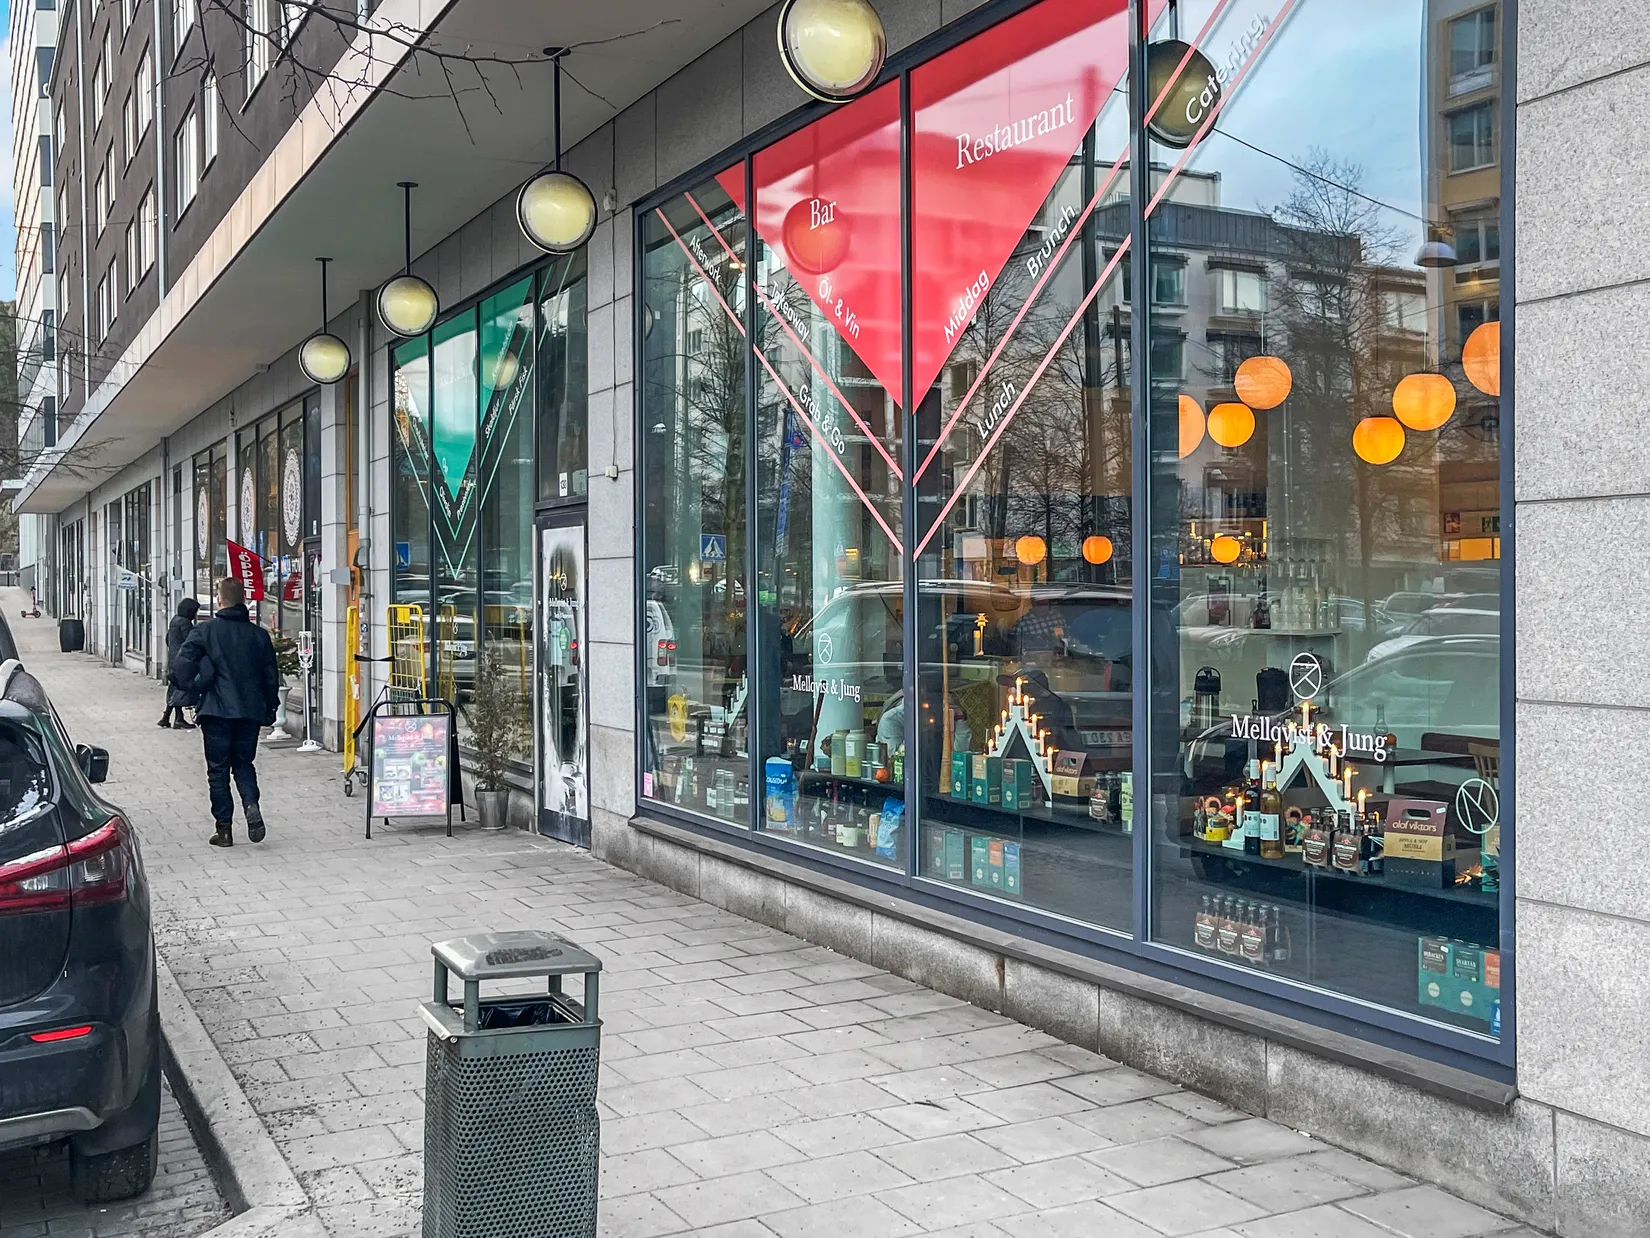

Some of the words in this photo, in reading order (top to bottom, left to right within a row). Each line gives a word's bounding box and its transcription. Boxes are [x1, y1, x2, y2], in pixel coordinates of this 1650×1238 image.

[1185, 12, 1269, 125] Catering
[955, 92, 1076, 170] Restaurant
[809, 198, 837, 231] Bar
[1026, 204, 1076, 280] Brunch
[689, 235, 722, 286] Afterwork
[771, 280, 811, 344] Takeaway
[818, 275, 834, 306] Öl-
[834, 299, 843, 319] &
[845, 307, 861, 340] Vin
[943, 269, 990, 344] Middag
[799, 383, 821, 423] Grab
[821, 412, 831, 433] &
[830, 424, 846, 455] Go
[976, 380, 1017, 440] Lunch
[238, 551, 256, 599] ÖPPET
[792, 674, 829, 698] Mellqvist
[830, 679, 838, 695] &
[838, 679, 861, 703] Jung
[1231, 714, 1315, 747] Mellqvist
[1319, 724, 1335, 747] &
[1336, 723, 1388, 762] Jung
